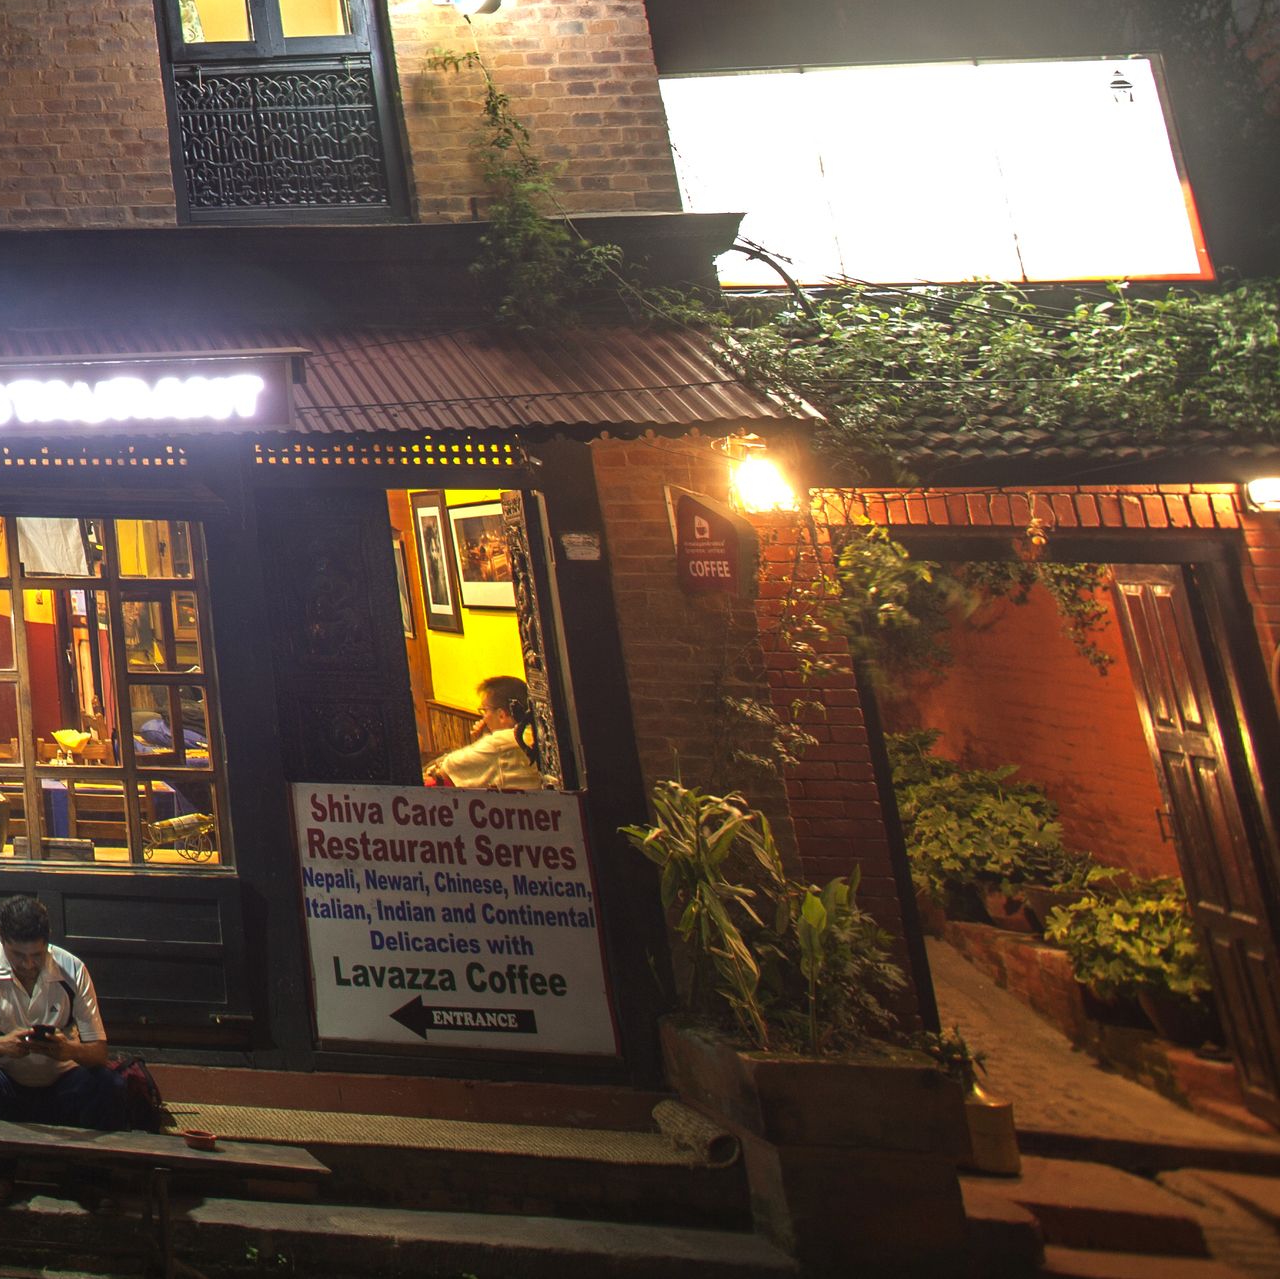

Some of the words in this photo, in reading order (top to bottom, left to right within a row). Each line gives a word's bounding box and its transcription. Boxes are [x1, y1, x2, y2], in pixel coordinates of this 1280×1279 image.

[689, 561, 731, 577] COFFEE
[310, 792, 383, 824] Shiva
[469, 798, 562, 832] Corner
[307, 827, 468, 866] Restaurant
[475, 833, 577, 871] Serves
[302, 867, 361, 894] Nepali,
[365, 869, 431, 896] Newari,
[434, 871, 508, 899] Chinese,
[512, 874, 593, 902] Mexican,
[305, 897, 372, 925] Italian,
[376, 899, 436, 923] Indian
[441, 902, 476, 924] and
[481, 902, 596, 929] Continental
[370, 929, 481, 955] Delicacies
[486, 934, 535, 956] with
[333, 955, 457, 992] Lavazza
[466, 961, 568, 997] Coffee
[432, 1009, 520, 1029] ENTRANCE
